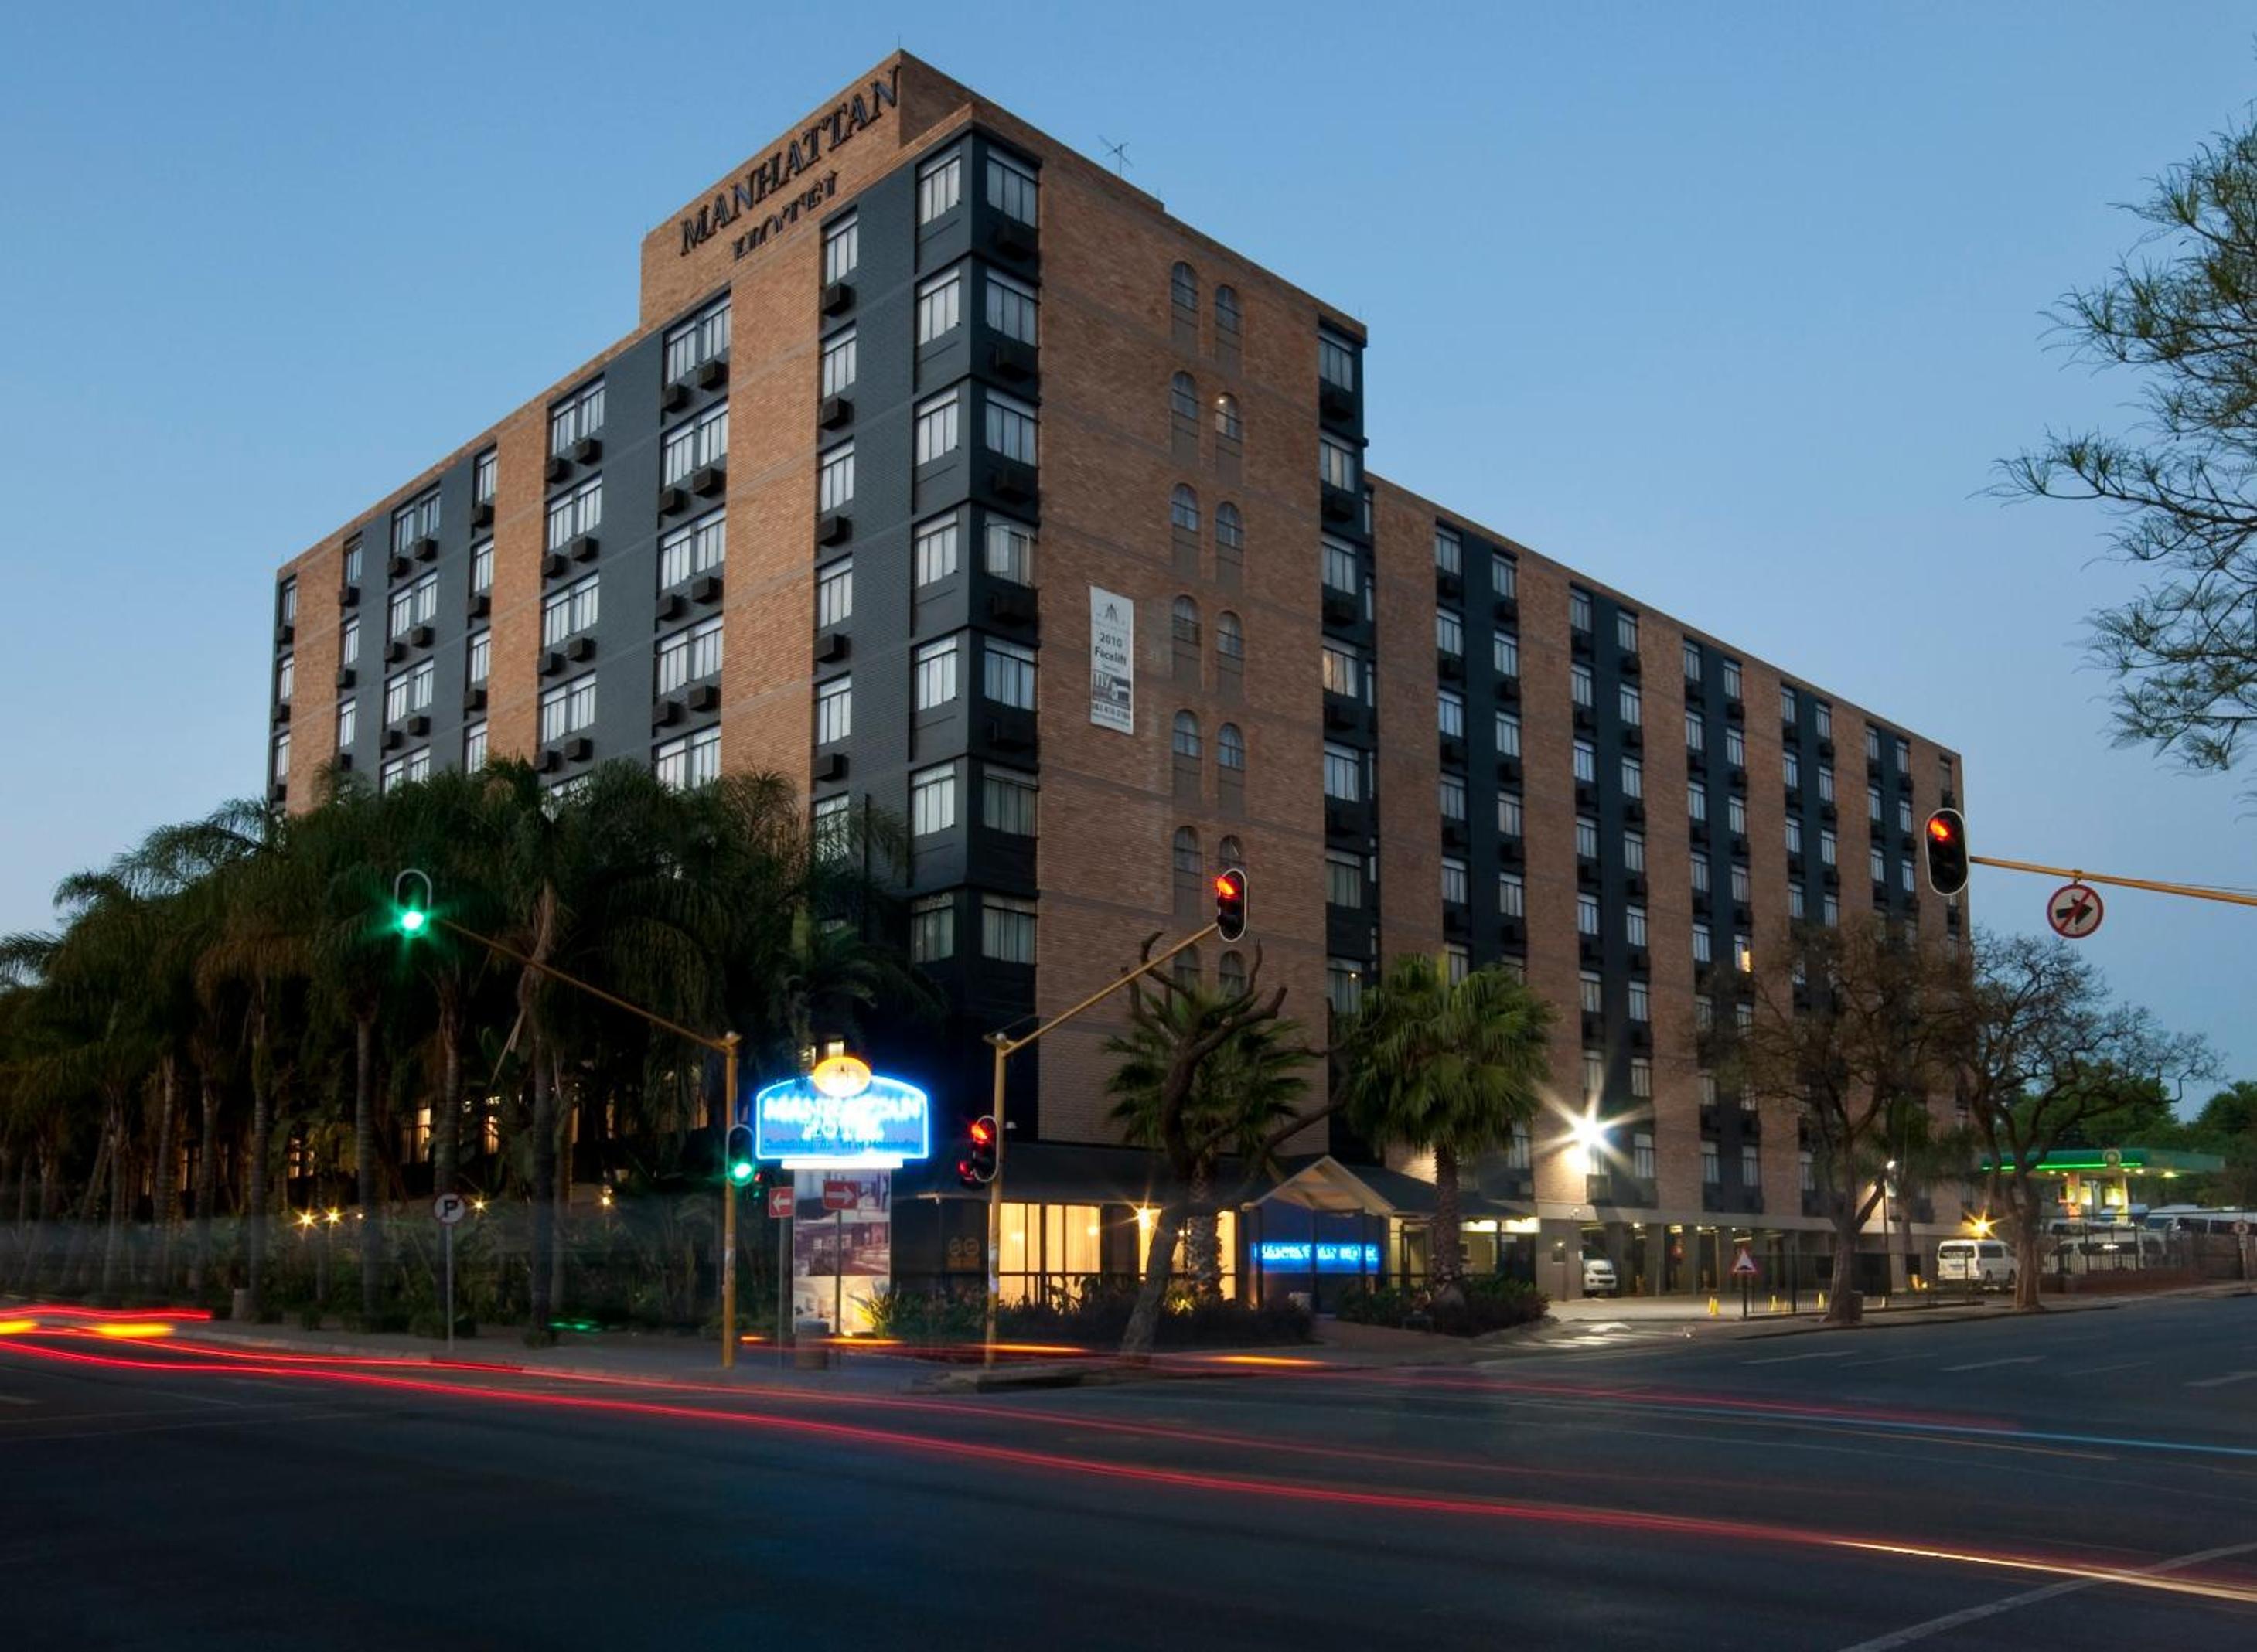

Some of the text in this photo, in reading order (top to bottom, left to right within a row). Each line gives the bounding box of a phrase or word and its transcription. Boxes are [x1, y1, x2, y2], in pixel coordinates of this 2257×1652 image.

[680, 65, 900, 256] MANHATTAN
[733, 169, 837, 260] HOTEL
[1100, 632, 1123, 648] 2010
[444, 1200, 458, 1218] P
